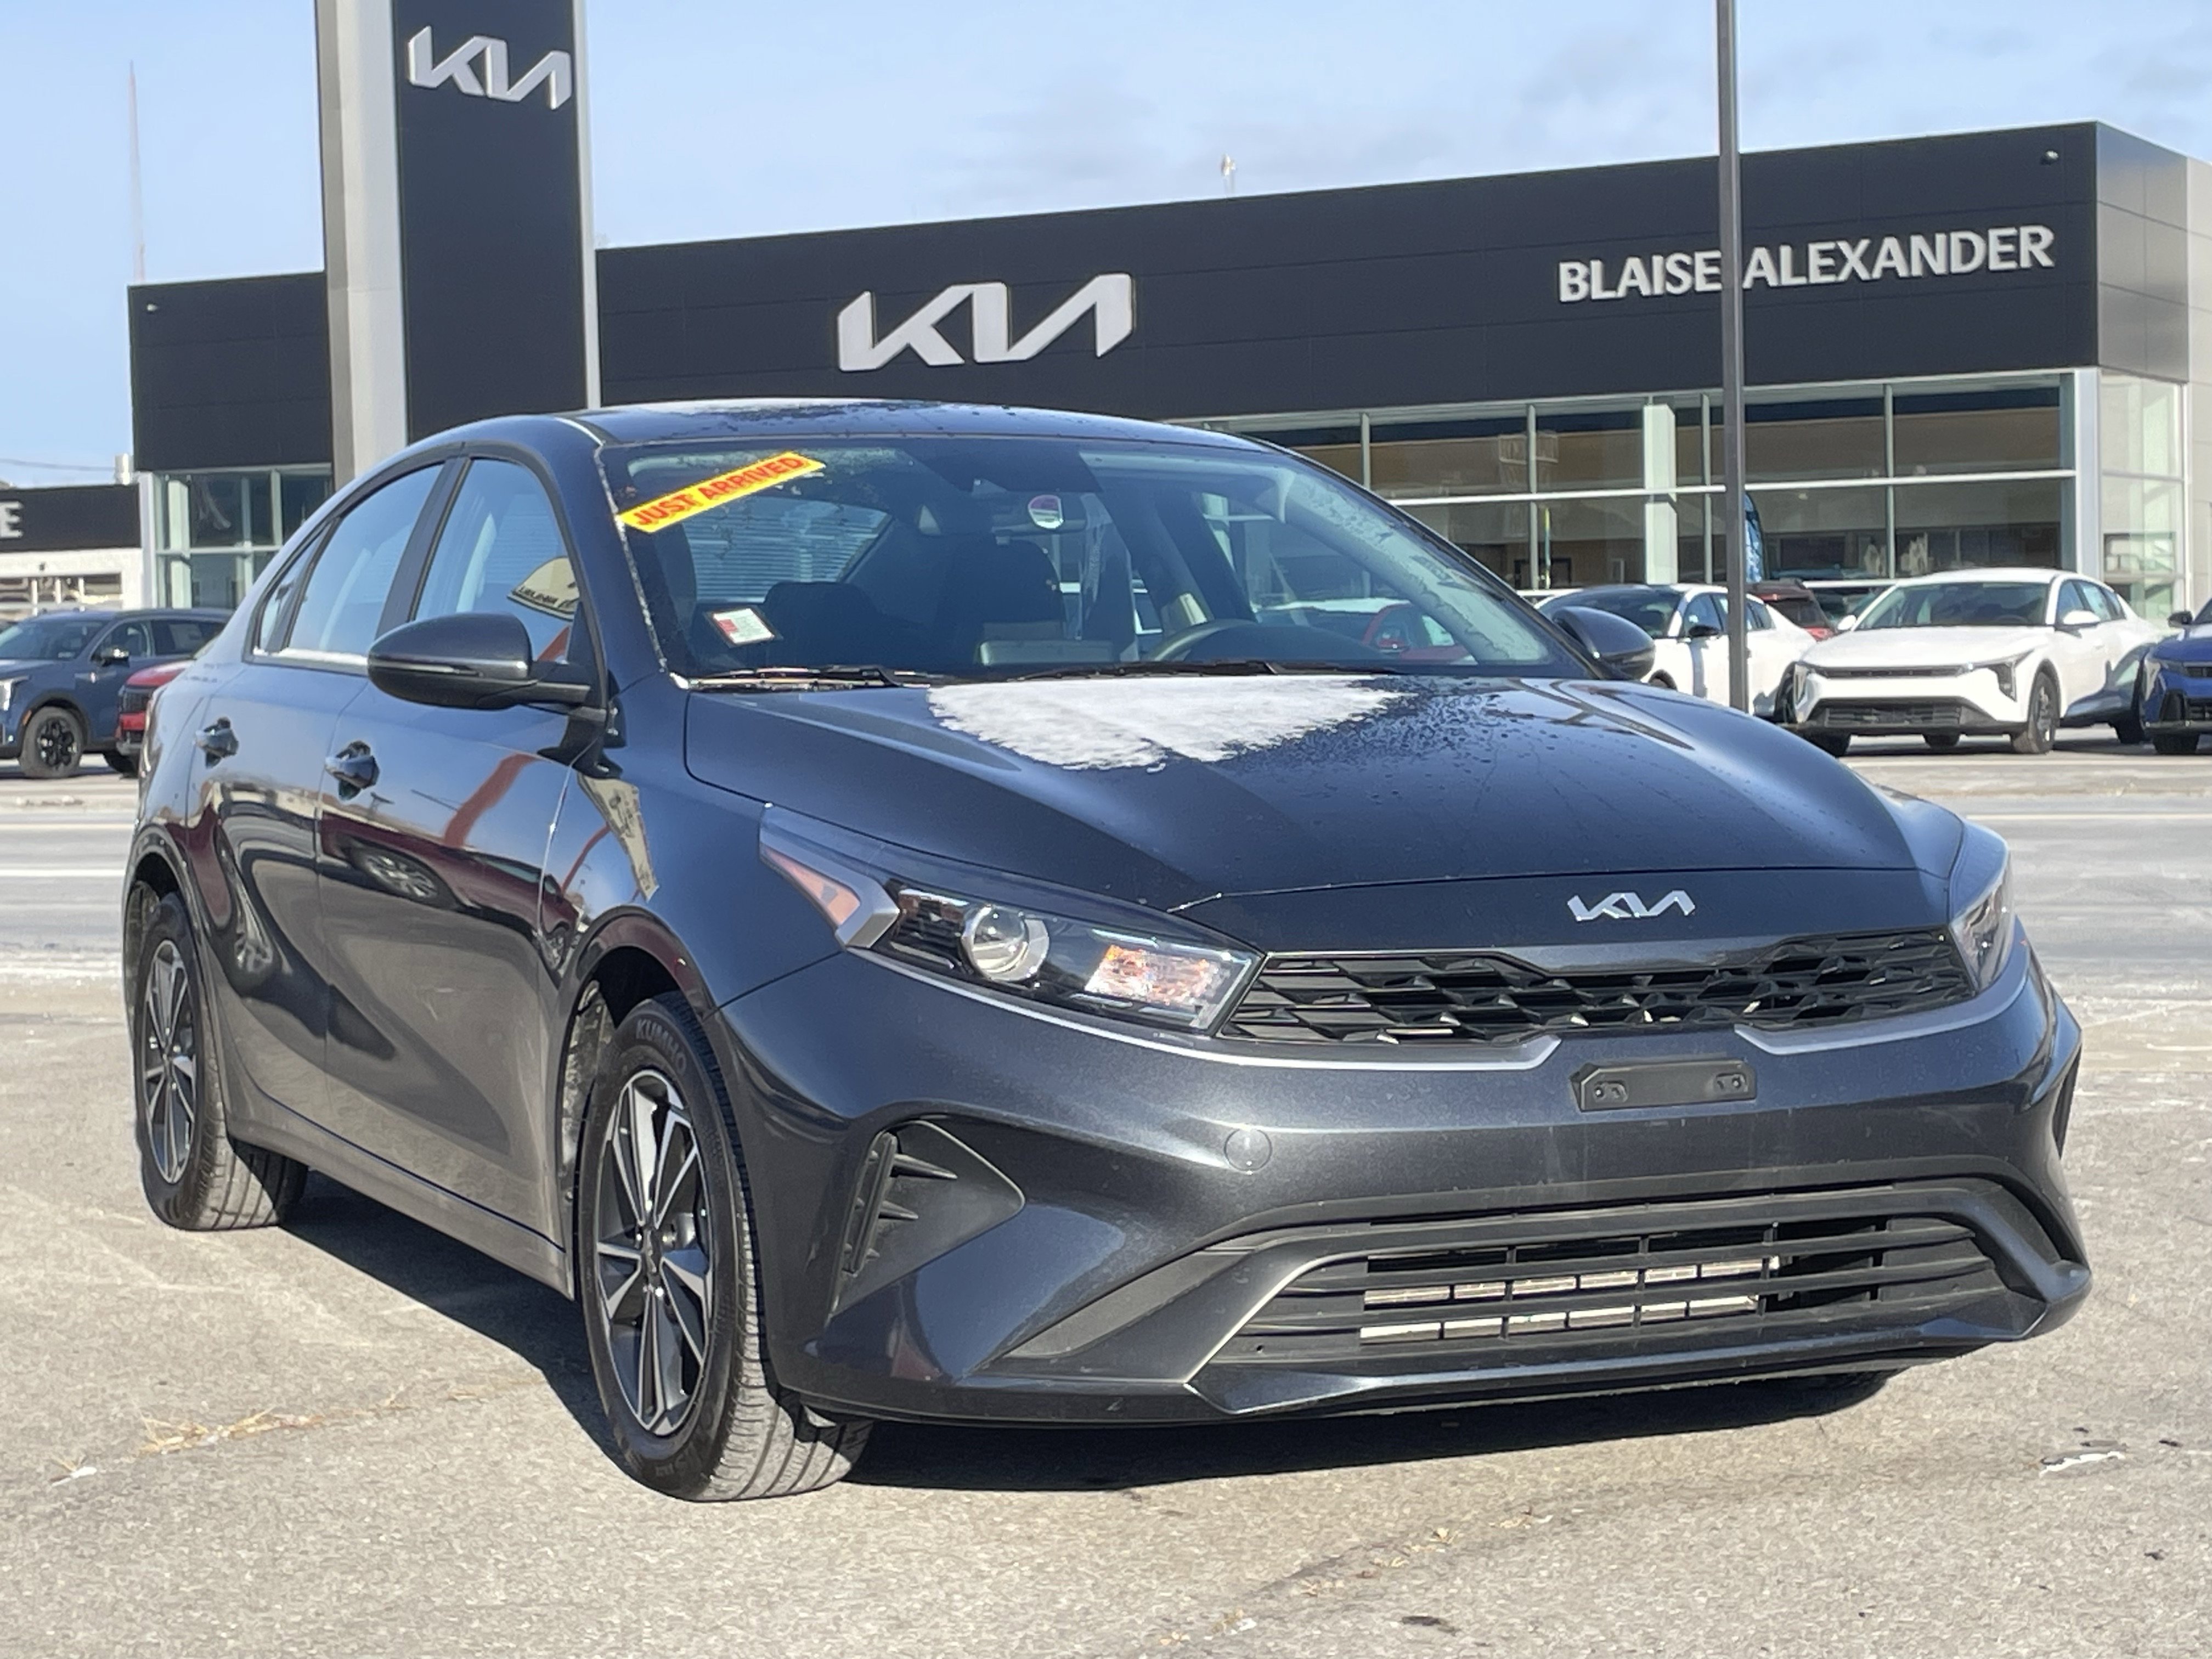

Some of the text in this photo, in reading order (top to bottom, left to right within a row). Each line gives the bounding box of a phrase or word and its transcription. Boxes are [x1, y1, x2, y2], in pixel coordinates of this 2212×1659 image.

[409, 25, 572, 110] KIA
[1559, 224, 2055, 303] BLAISE ALEXANDER
[837, 272, 1135, 371] KIA
[634, 457, 809, 526] JUST ARRIVED
[1567, 890, 1695, 922] KIA
[636, 1018, 686, 1075] KUMHO
